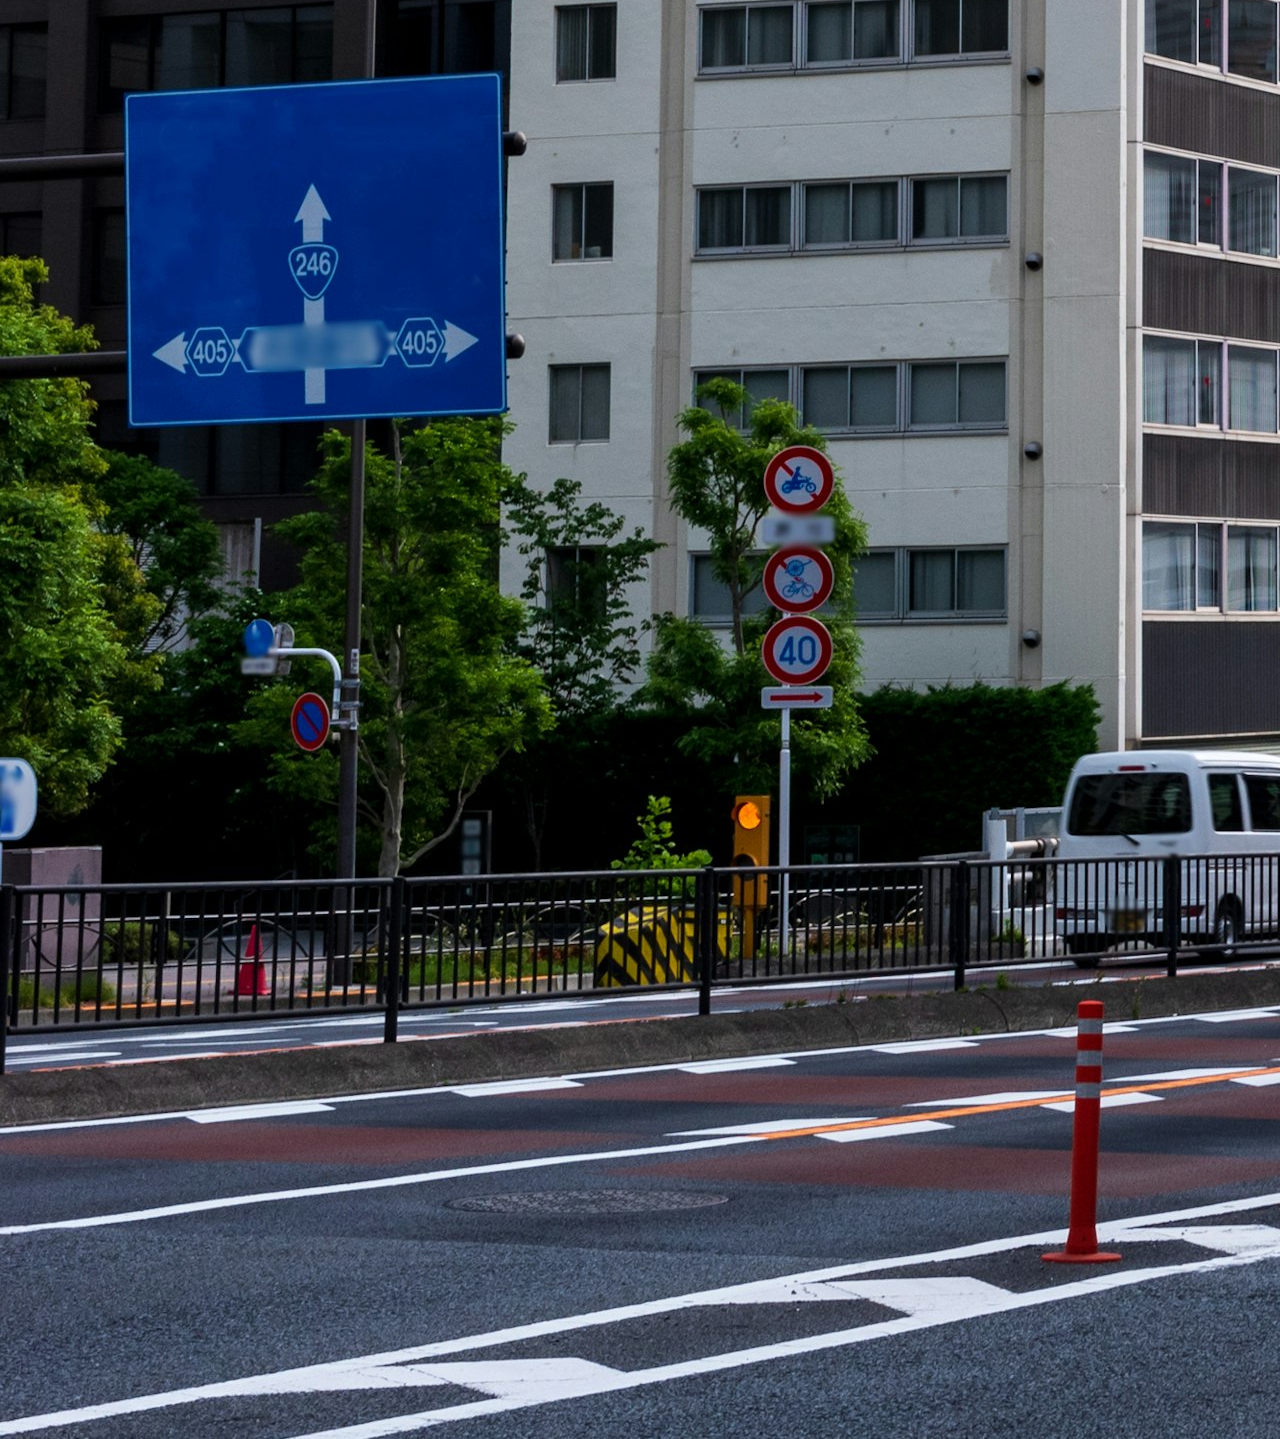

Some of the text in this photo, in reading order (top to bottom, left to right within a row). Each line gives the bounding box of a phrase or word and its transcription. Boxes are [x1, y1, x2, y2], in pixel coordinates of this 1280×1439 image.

[296, 251, 331, 276] 246
[193, 339, 228, 364] 405
[402, 330, 437, 355] 405
[779, 635, 816, 666] 40
